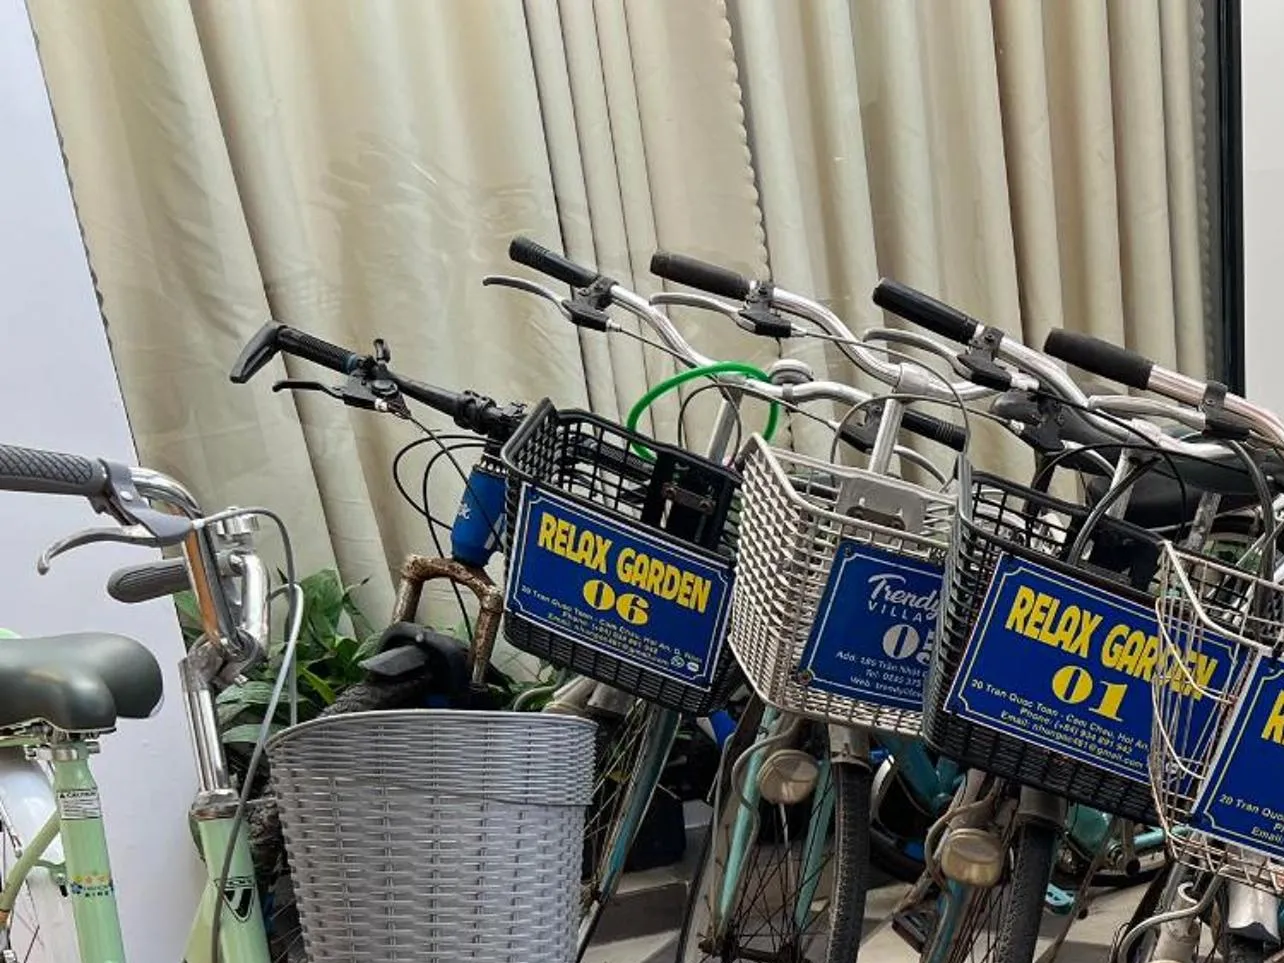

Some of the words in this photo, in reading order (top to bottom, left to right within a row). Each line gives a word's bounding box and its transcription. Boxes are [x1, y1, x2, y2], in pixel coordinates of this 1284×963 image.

[538, 512, 613, 574] RELAX
[616, 548, 711, 613] GARDEN
[583, 579, 649, 625] 06
[868, 573, 940, 620] Trendy
[868, 600, 922, 622] VILLA
[1005, 585, 1103, 658] RELAX
[1052, 665, 1128, 722] 01
[1236, 798, 1259, 814] Tran
